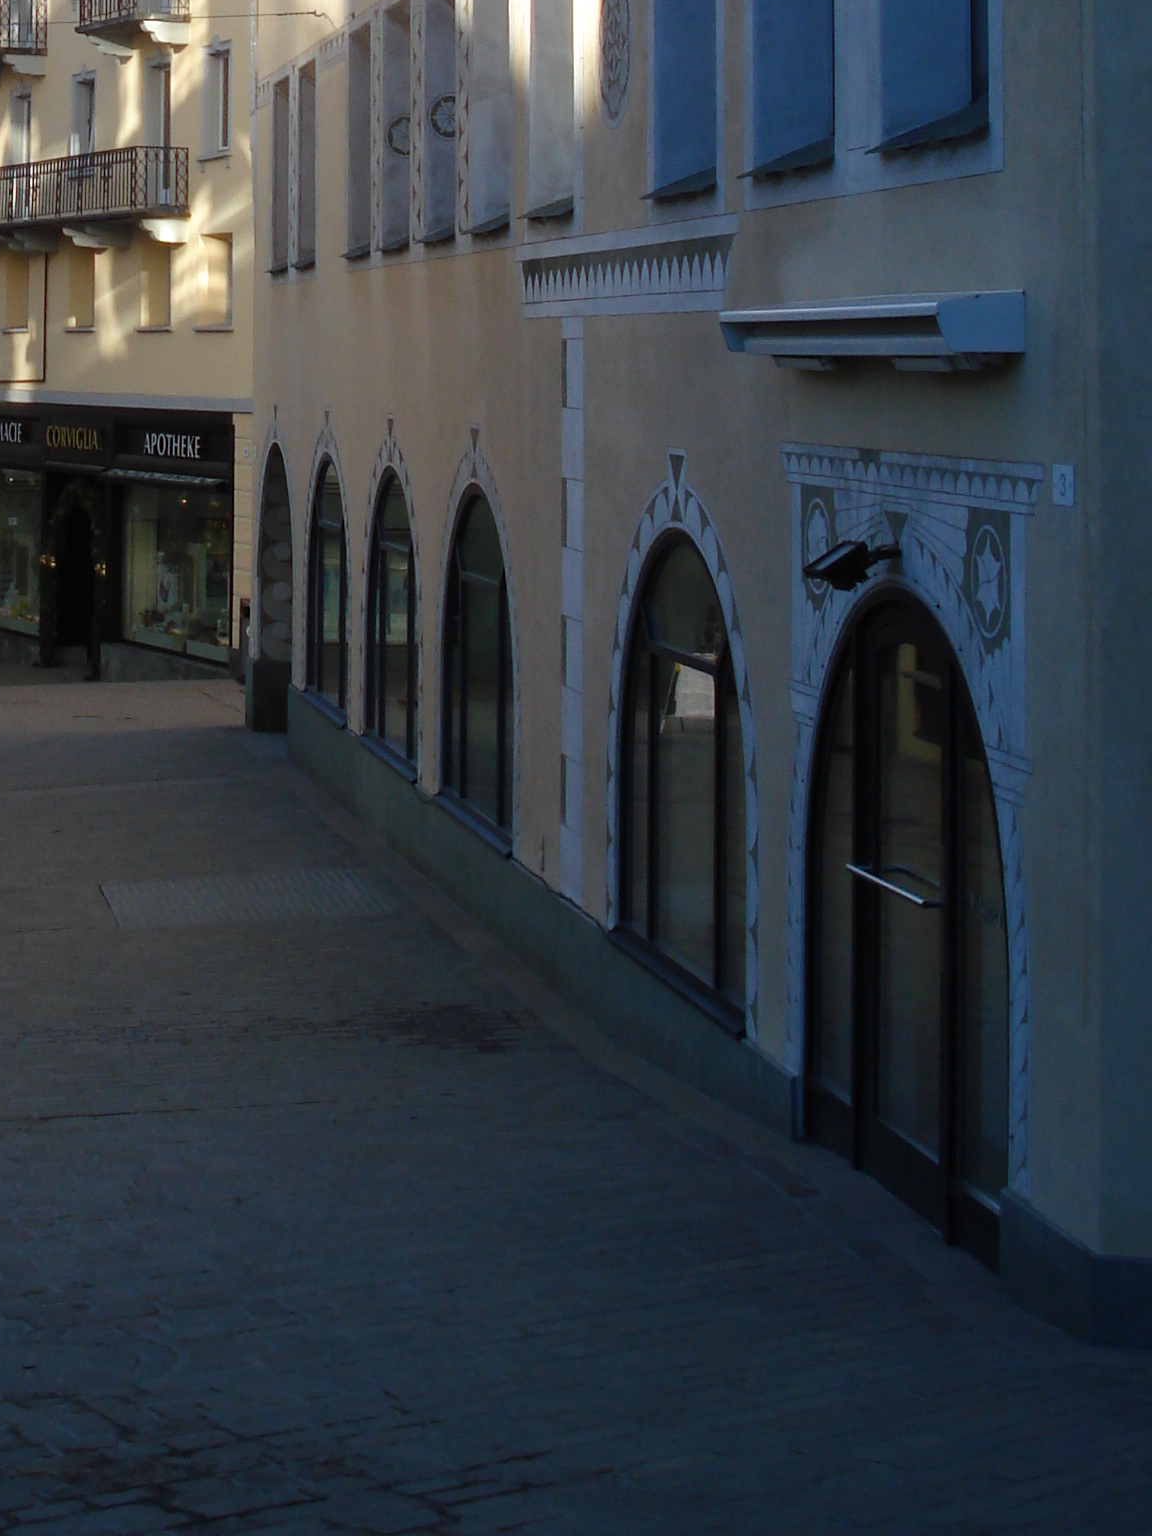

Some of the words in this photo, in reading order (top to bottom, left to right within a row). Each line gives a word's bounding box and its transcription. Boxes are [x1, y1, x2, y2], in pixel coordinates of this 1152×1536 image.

[47, 425, 99, 451] CORVIGLIA
[143, 432, 201, 459] APOTHEKE
[1059, 473, 1067, 497] 3
